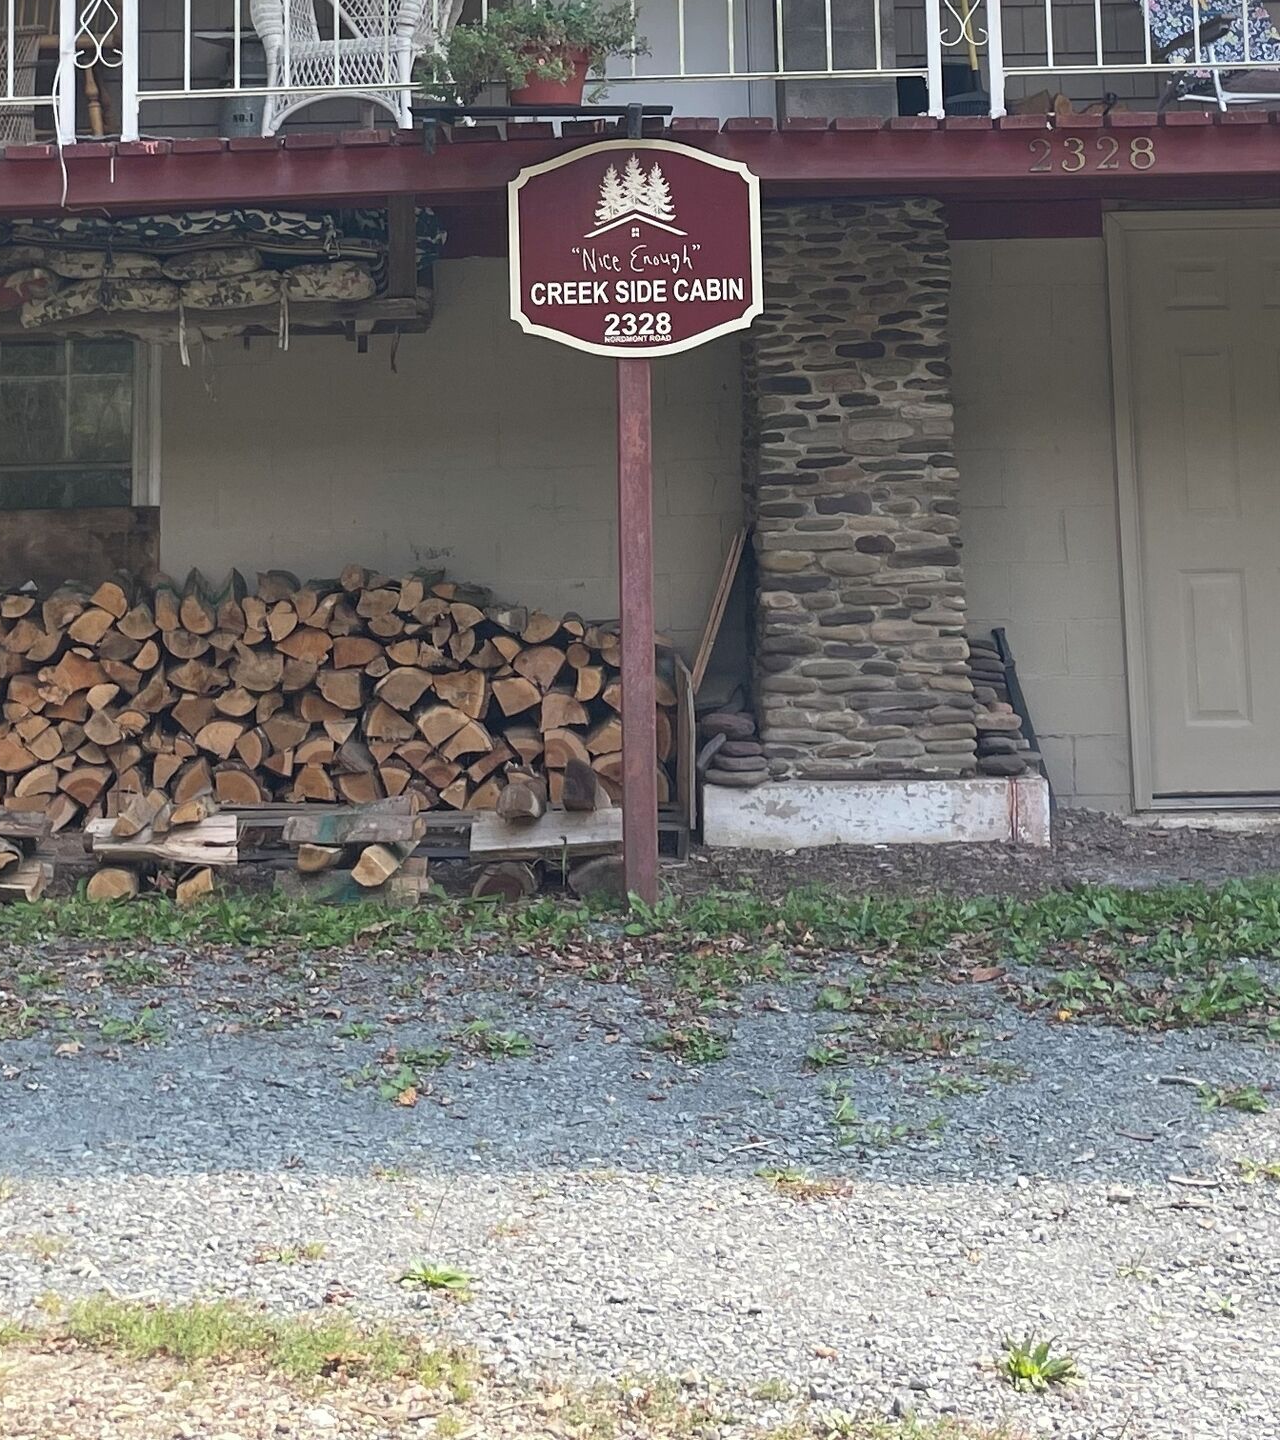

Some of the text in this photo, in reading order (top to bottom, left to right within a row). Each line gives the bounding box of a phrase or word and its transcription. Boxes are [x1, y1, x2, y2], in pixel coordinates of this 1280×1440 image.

[1028, 136, 1156, 172] 2328
[530, 277, 744, 306] CREEK SIDE CABIN
[604, 312, 672, 336] 2328
[649, 334, 672, 343] ROAD
